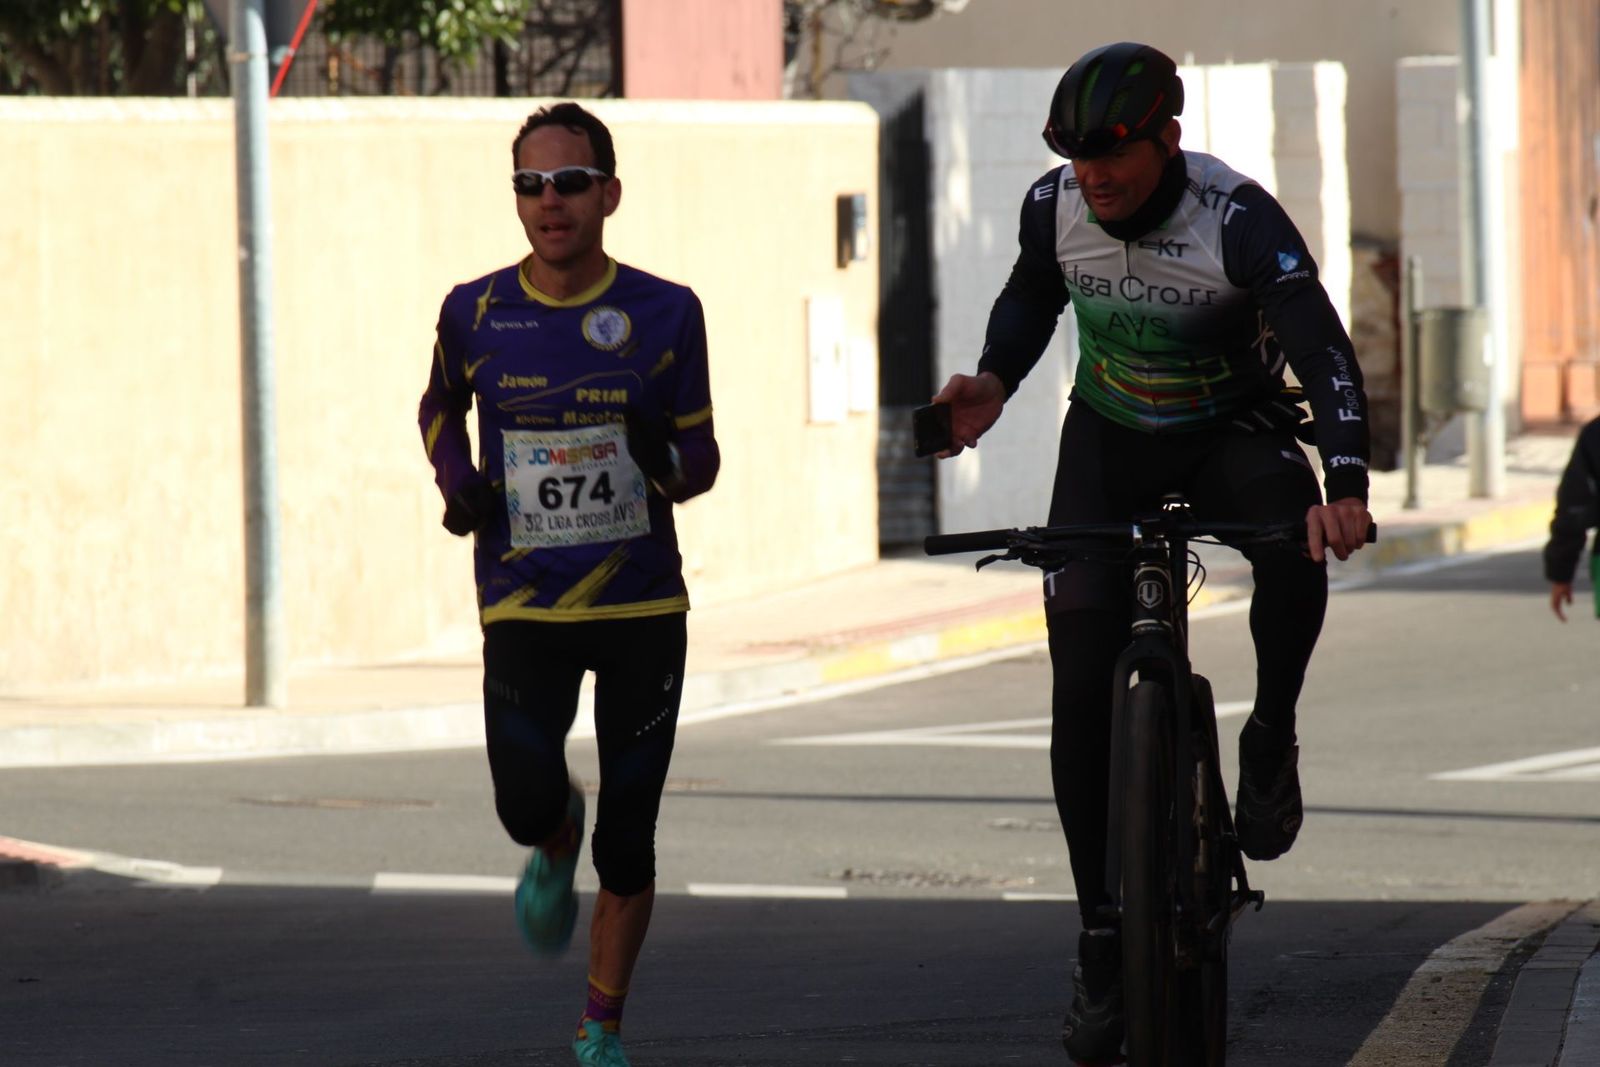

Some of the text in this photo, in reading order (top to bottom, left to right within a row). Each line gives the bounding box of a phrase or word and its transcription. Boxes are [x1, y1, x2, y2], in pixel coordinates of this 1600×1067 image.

[575, 388, 628, 404] PRIM
[528, 441, 618, 465] JOMISAGA
[538, 470, 616, 511] 674
[523, 501, 636, 533] 32 LIGA CROSS AVS
